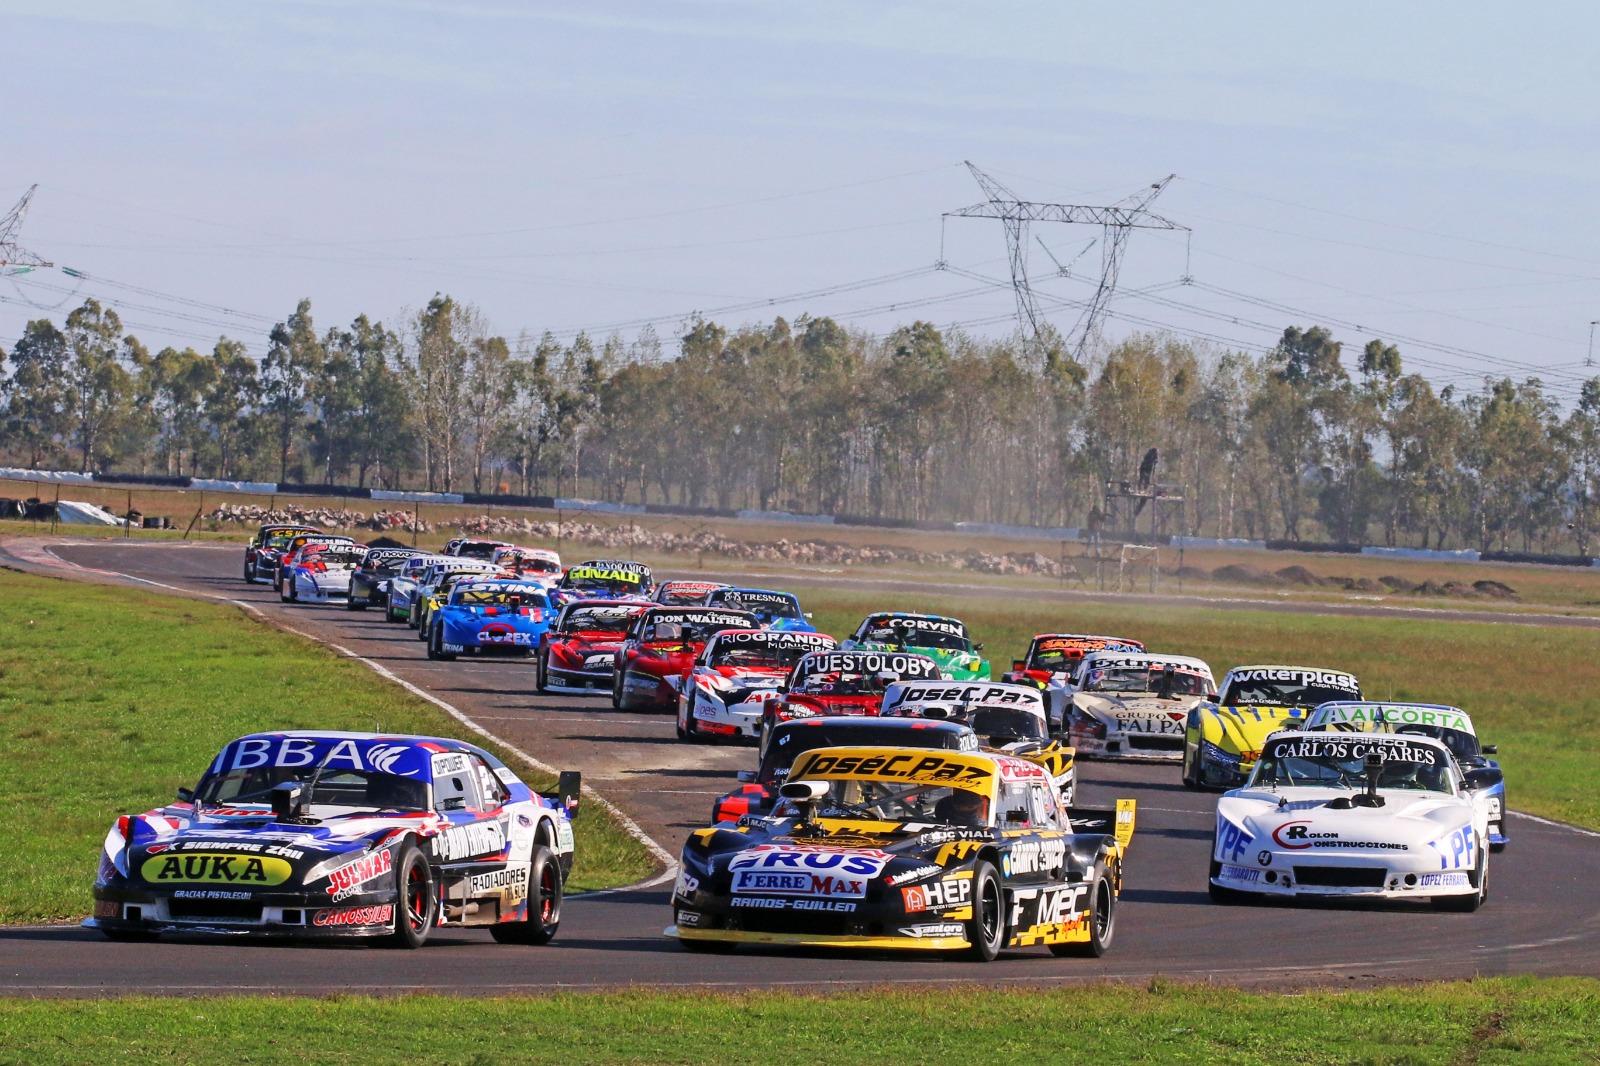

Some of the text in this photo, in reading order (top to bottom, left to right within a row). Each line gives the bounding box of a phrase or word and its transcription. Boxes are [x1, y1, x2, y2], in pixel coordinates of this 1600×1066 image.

[569, 568, 640, 584] GONZALO
[742, 593, 789, 605] TRESNAL
[654, 614, 684, 624] DON
[686, 614, 752, 628] WALTHER
[889, 619, 963, 637] CORVEN
[1233, 669, 1359, 691] waterplast
[1115, 711, 1167, 721] GRUPO
[1115, 719, 1186, 734] FALPA
[1302, 735, 1408, 747] FRIGORIFICO
[1274, 742, 1348, 759] CARLOS
[1353, 744, 1435, 765] CASARES
[181, 841, 262, 853] SIEMPRE
[1427, 824, 1474, 870] YPF
[157, 855, 268, 882] AUKA
[326, 848, 392, 895] JULMAR
[472, 867, 527, 892] RADIADORES
[1420, 874, 1442, 886] LOPEZ
[174, 890, 206, 899] GRACIAS
[921, 879, 971, 906] HEP
[731, 897, 857, 913] RAMOS-GUILLEN
[313, 904, 393, 927] CANOSSILEN
